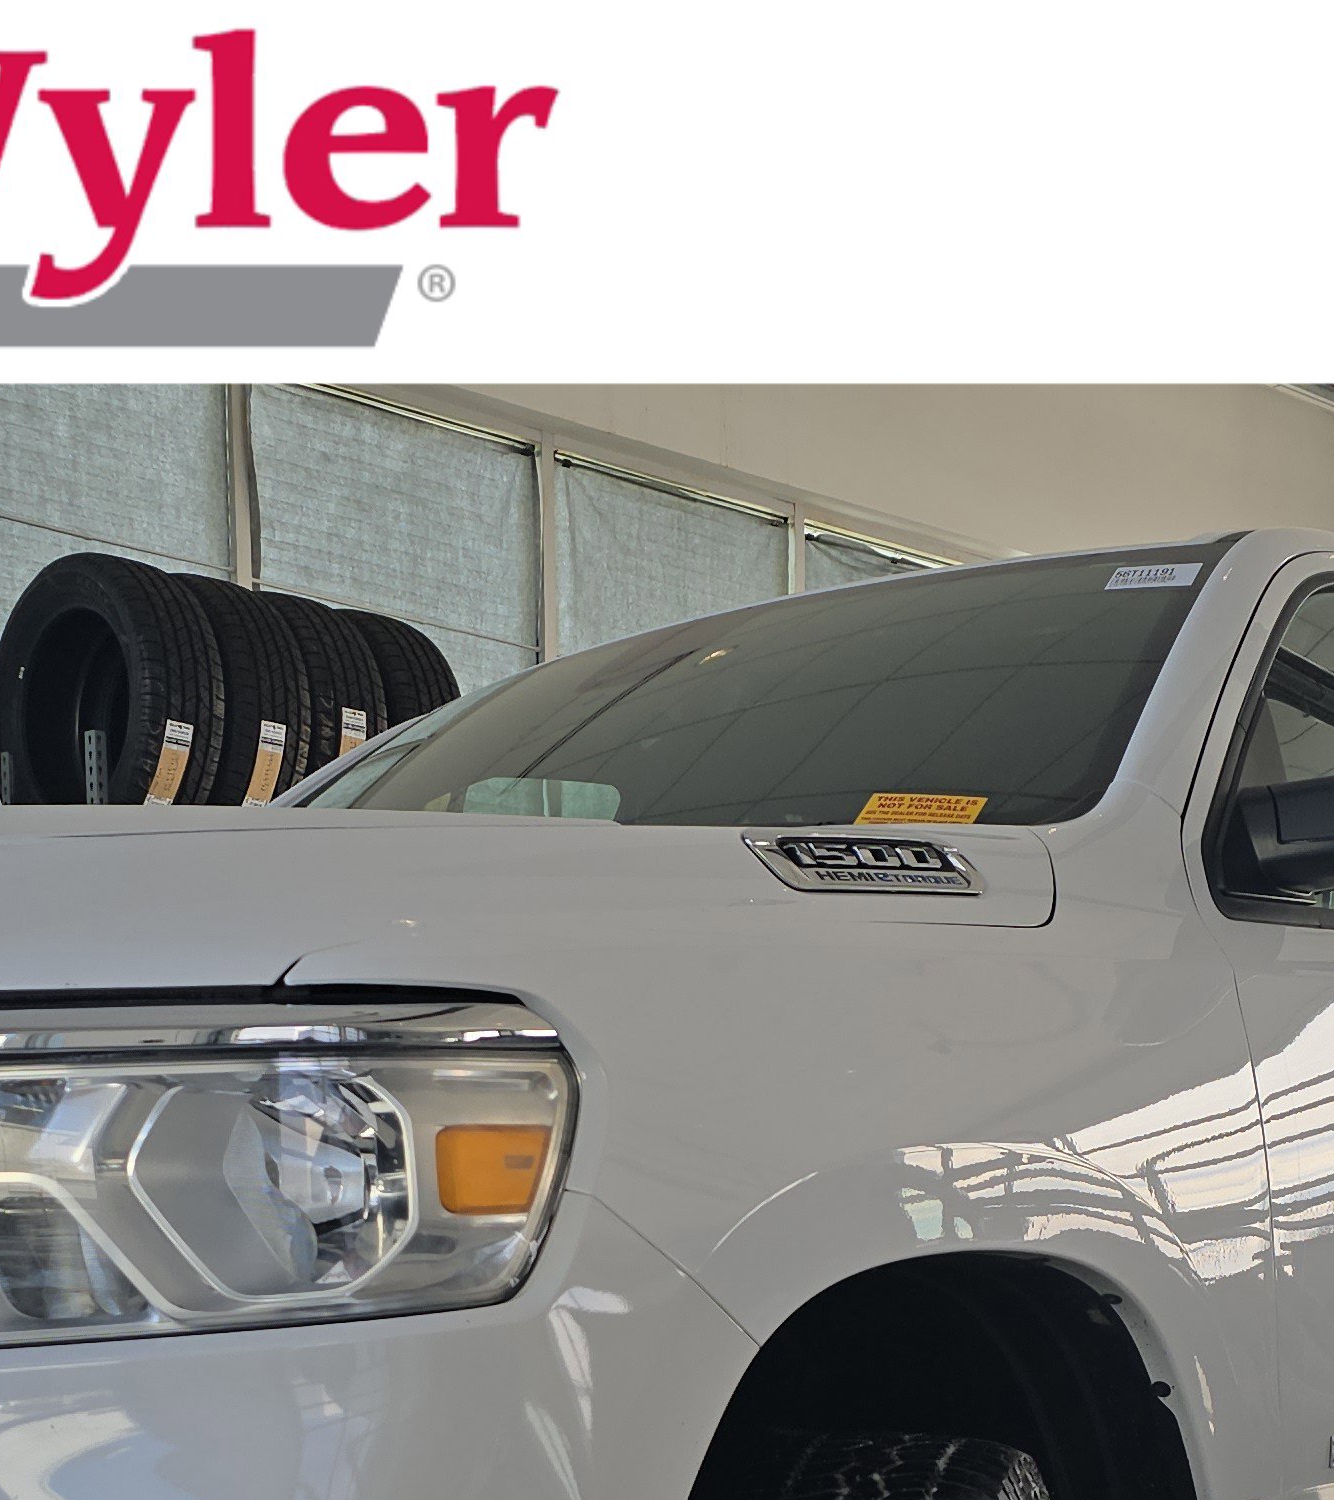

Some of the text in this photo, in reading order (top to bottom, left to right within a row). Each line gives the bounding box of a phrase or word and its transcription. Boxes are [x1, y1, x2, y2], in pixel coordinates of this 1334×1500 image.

[909, 797, 962, 805] VEHICLE
[936, 804, 969, 812] SALE
[783, 842, 943, 869] 1500
[816, 870, 875, 882] HEMI
